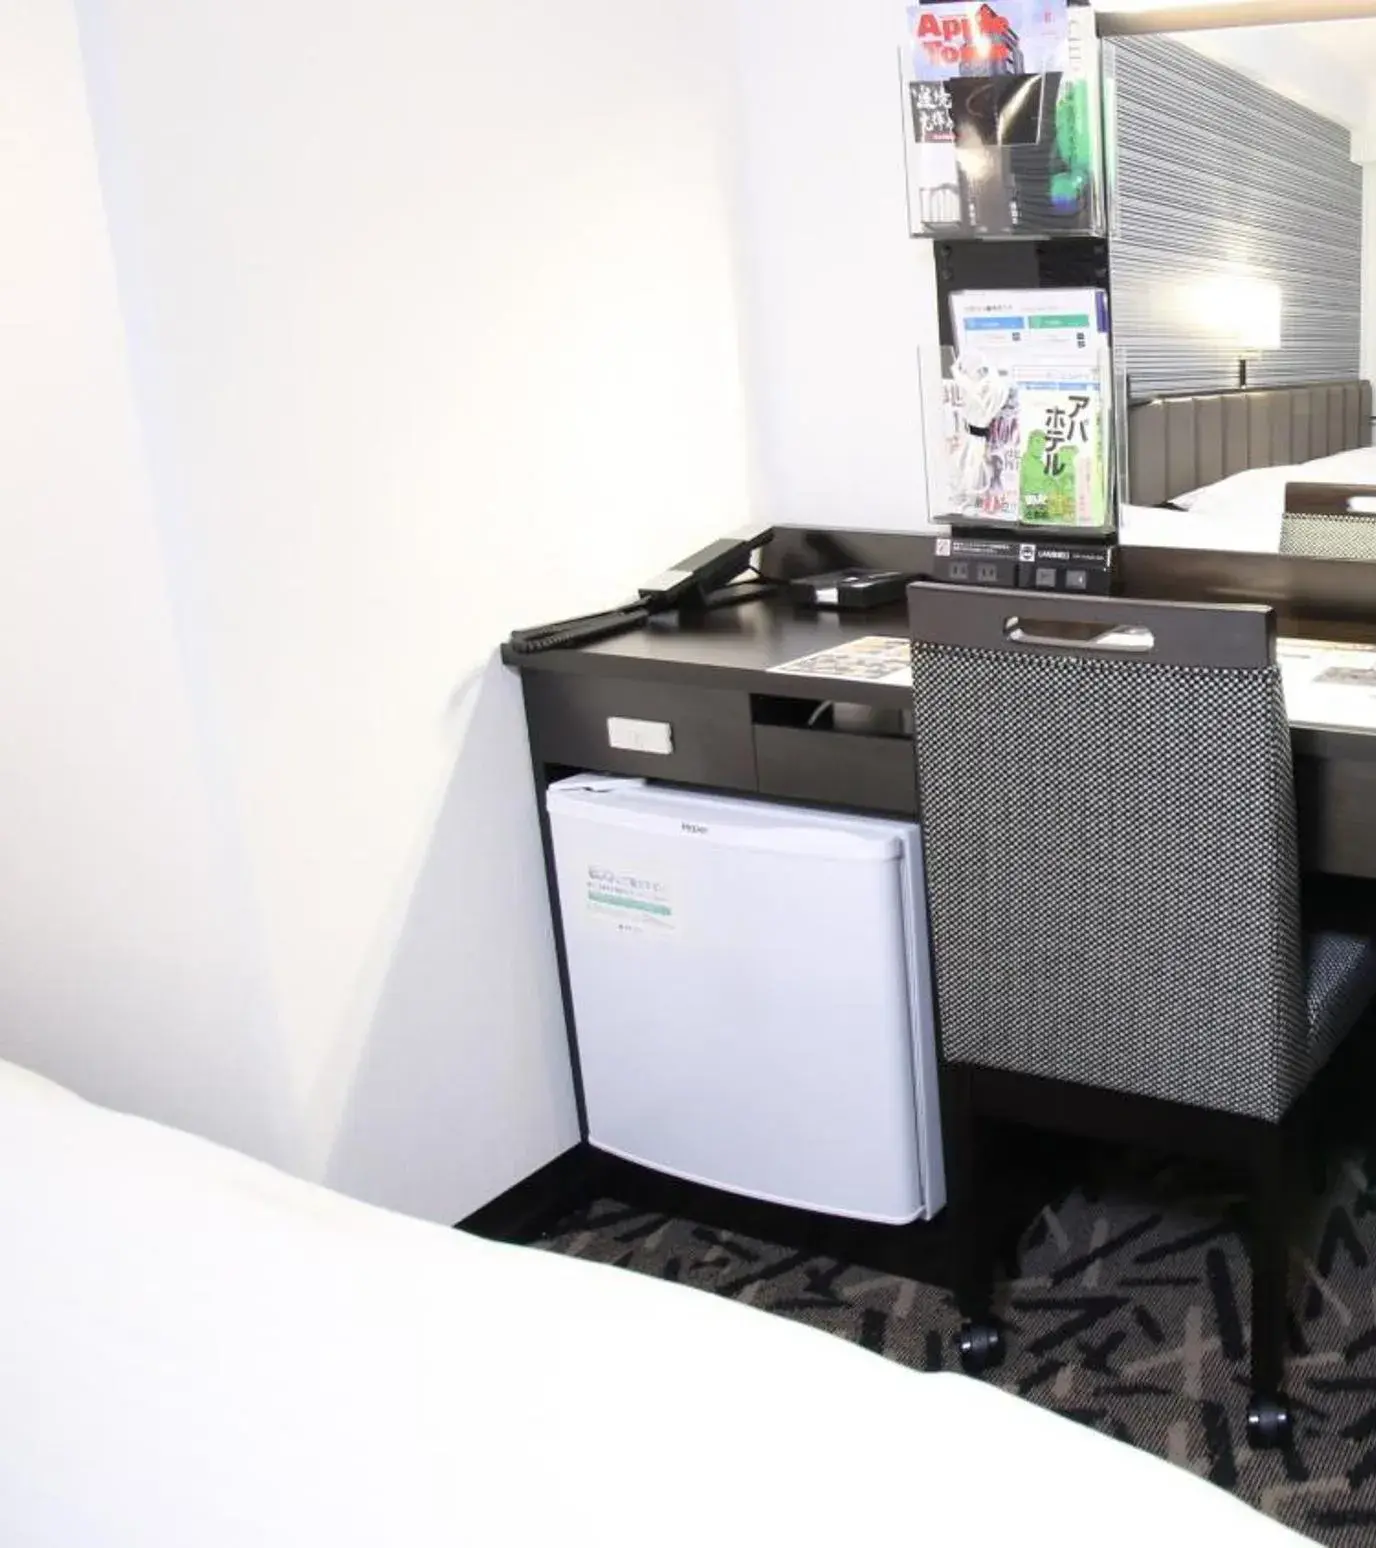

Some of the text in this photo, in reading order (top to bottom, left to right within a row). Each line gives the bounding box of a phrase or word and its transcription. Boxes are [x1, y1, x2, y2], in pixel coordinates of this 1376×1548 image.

[1043, 405, 1066, 476] ホテル
[1067, 395, 1090, 443] アパ
